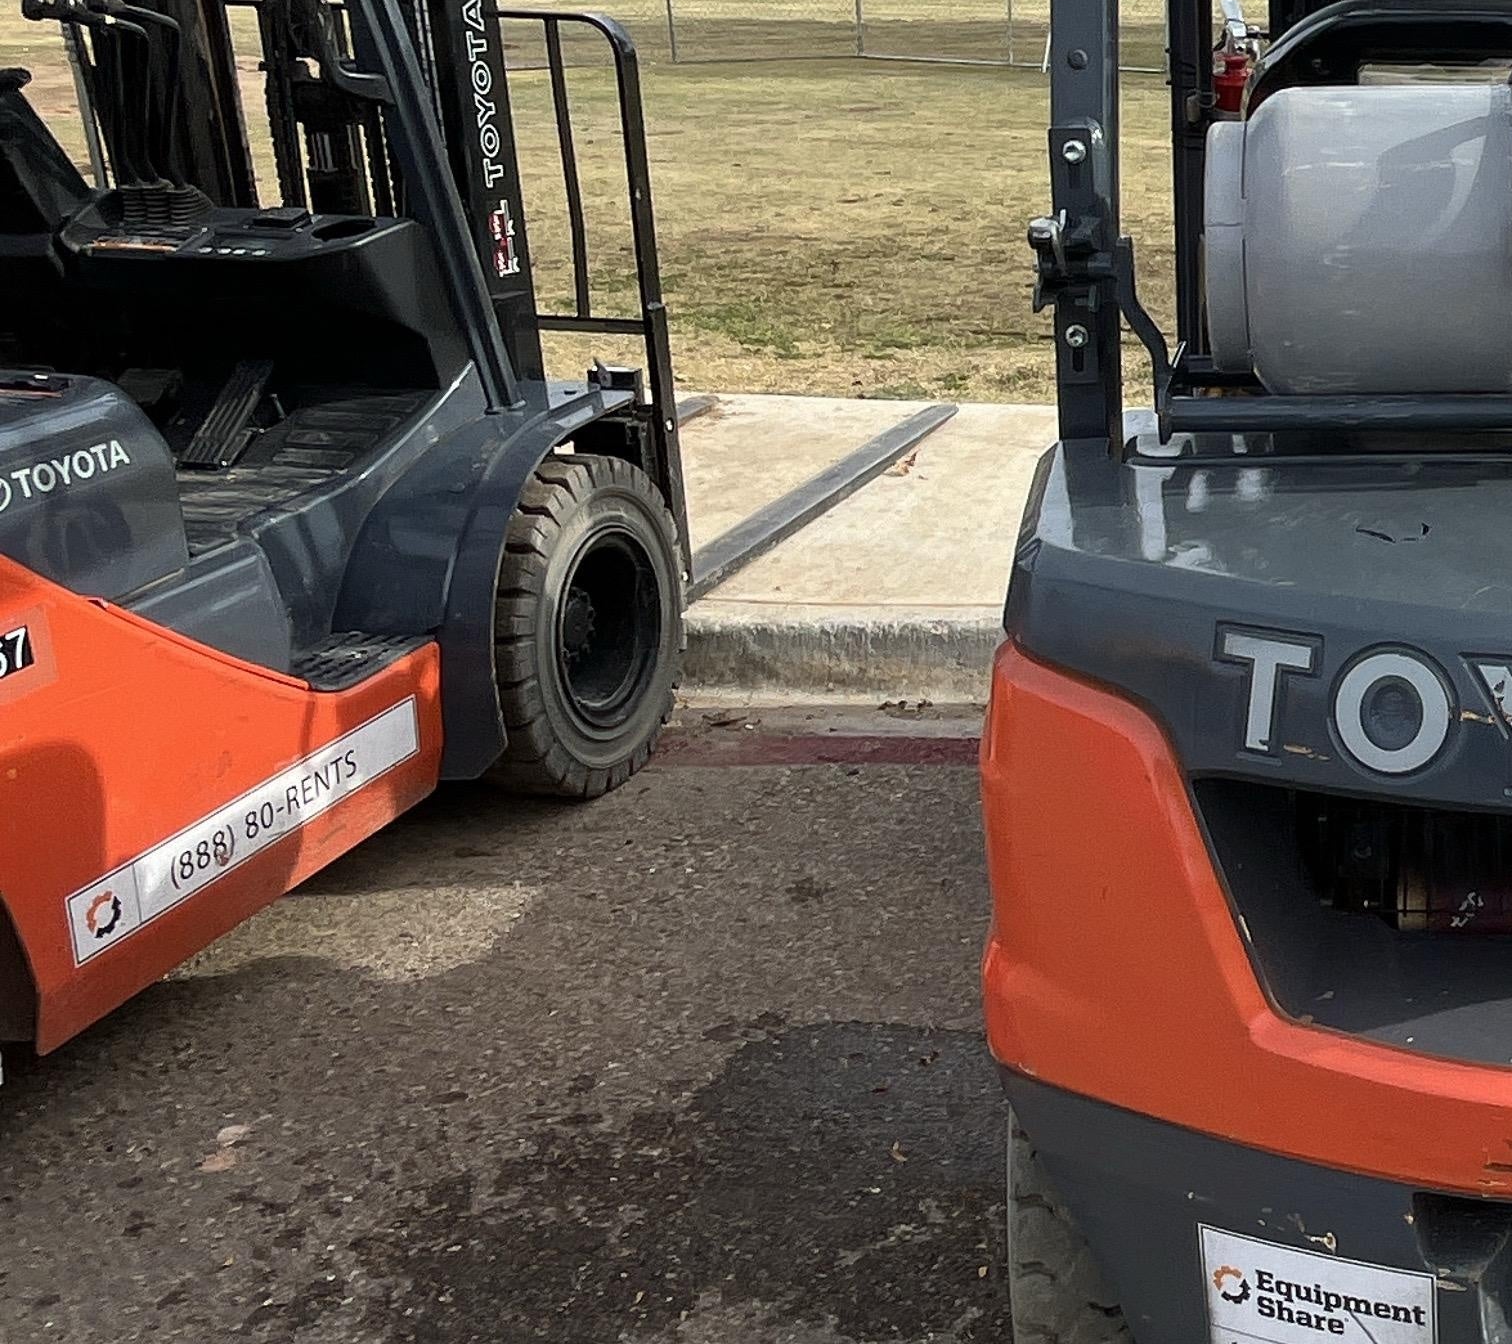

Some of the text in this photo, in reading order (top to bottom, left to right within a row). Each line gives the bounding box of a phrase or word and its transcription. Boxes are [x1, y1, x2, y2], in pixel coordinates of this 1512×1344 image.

[10, 439, 131, 499] TOYOTA
[169, 749, 358, 891] (888) 80-RENTS
[1254, 1268, 1427, 1327] Equipment
[1256, 1295, 1345, 1336] Share
